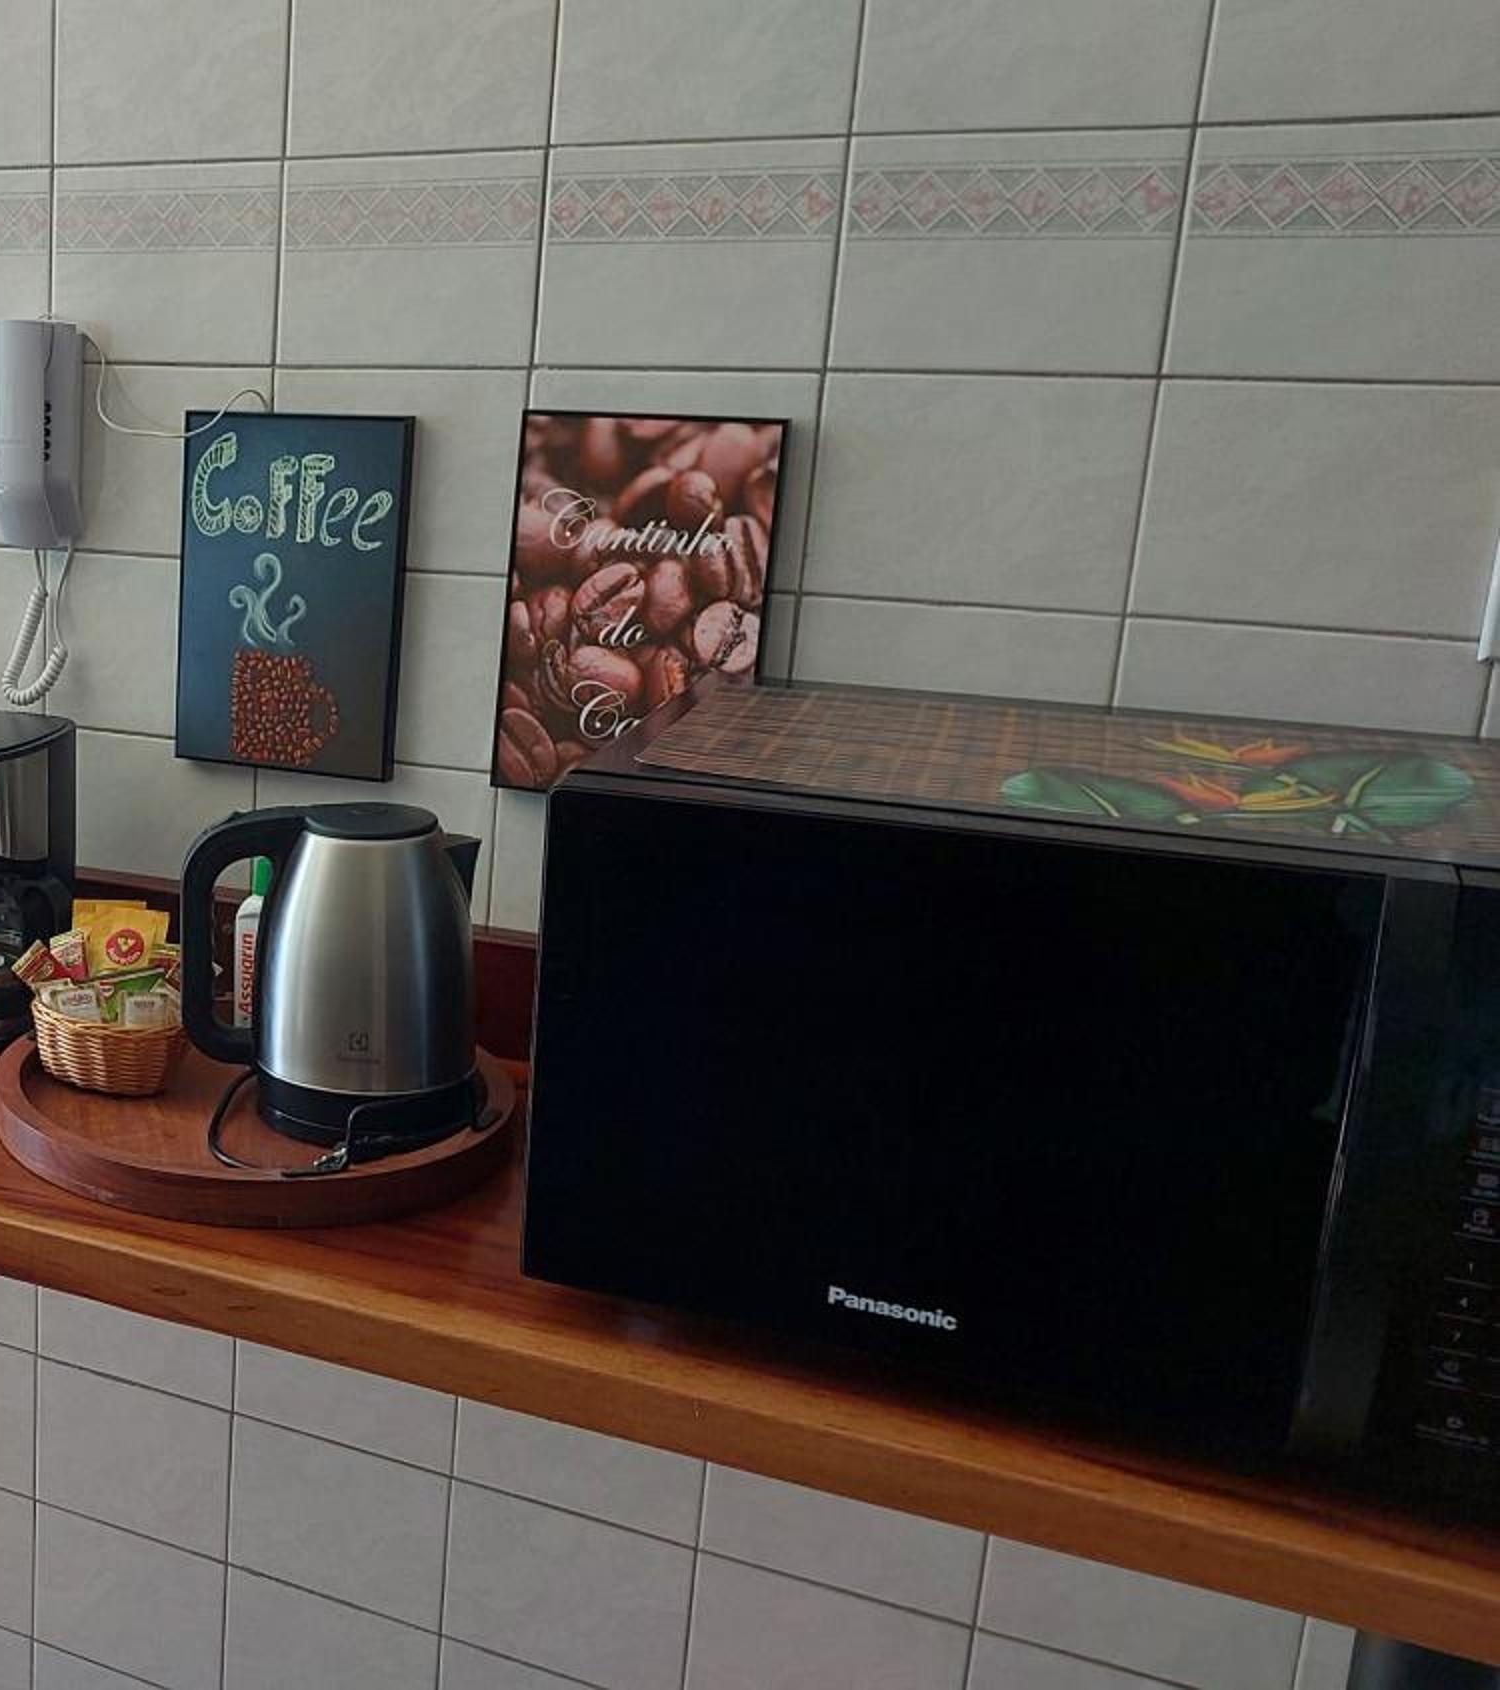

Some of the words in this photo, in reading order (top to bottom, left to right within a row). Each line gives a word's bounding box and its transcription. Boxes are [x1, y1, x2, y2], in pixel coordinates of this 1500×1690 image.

[542, 488, 733, 555] Cantinho
[598, 605, 647, 647] do
[571, 680, 643, 740] Ca
[827, 1285, 958, 1331] Panasonic
